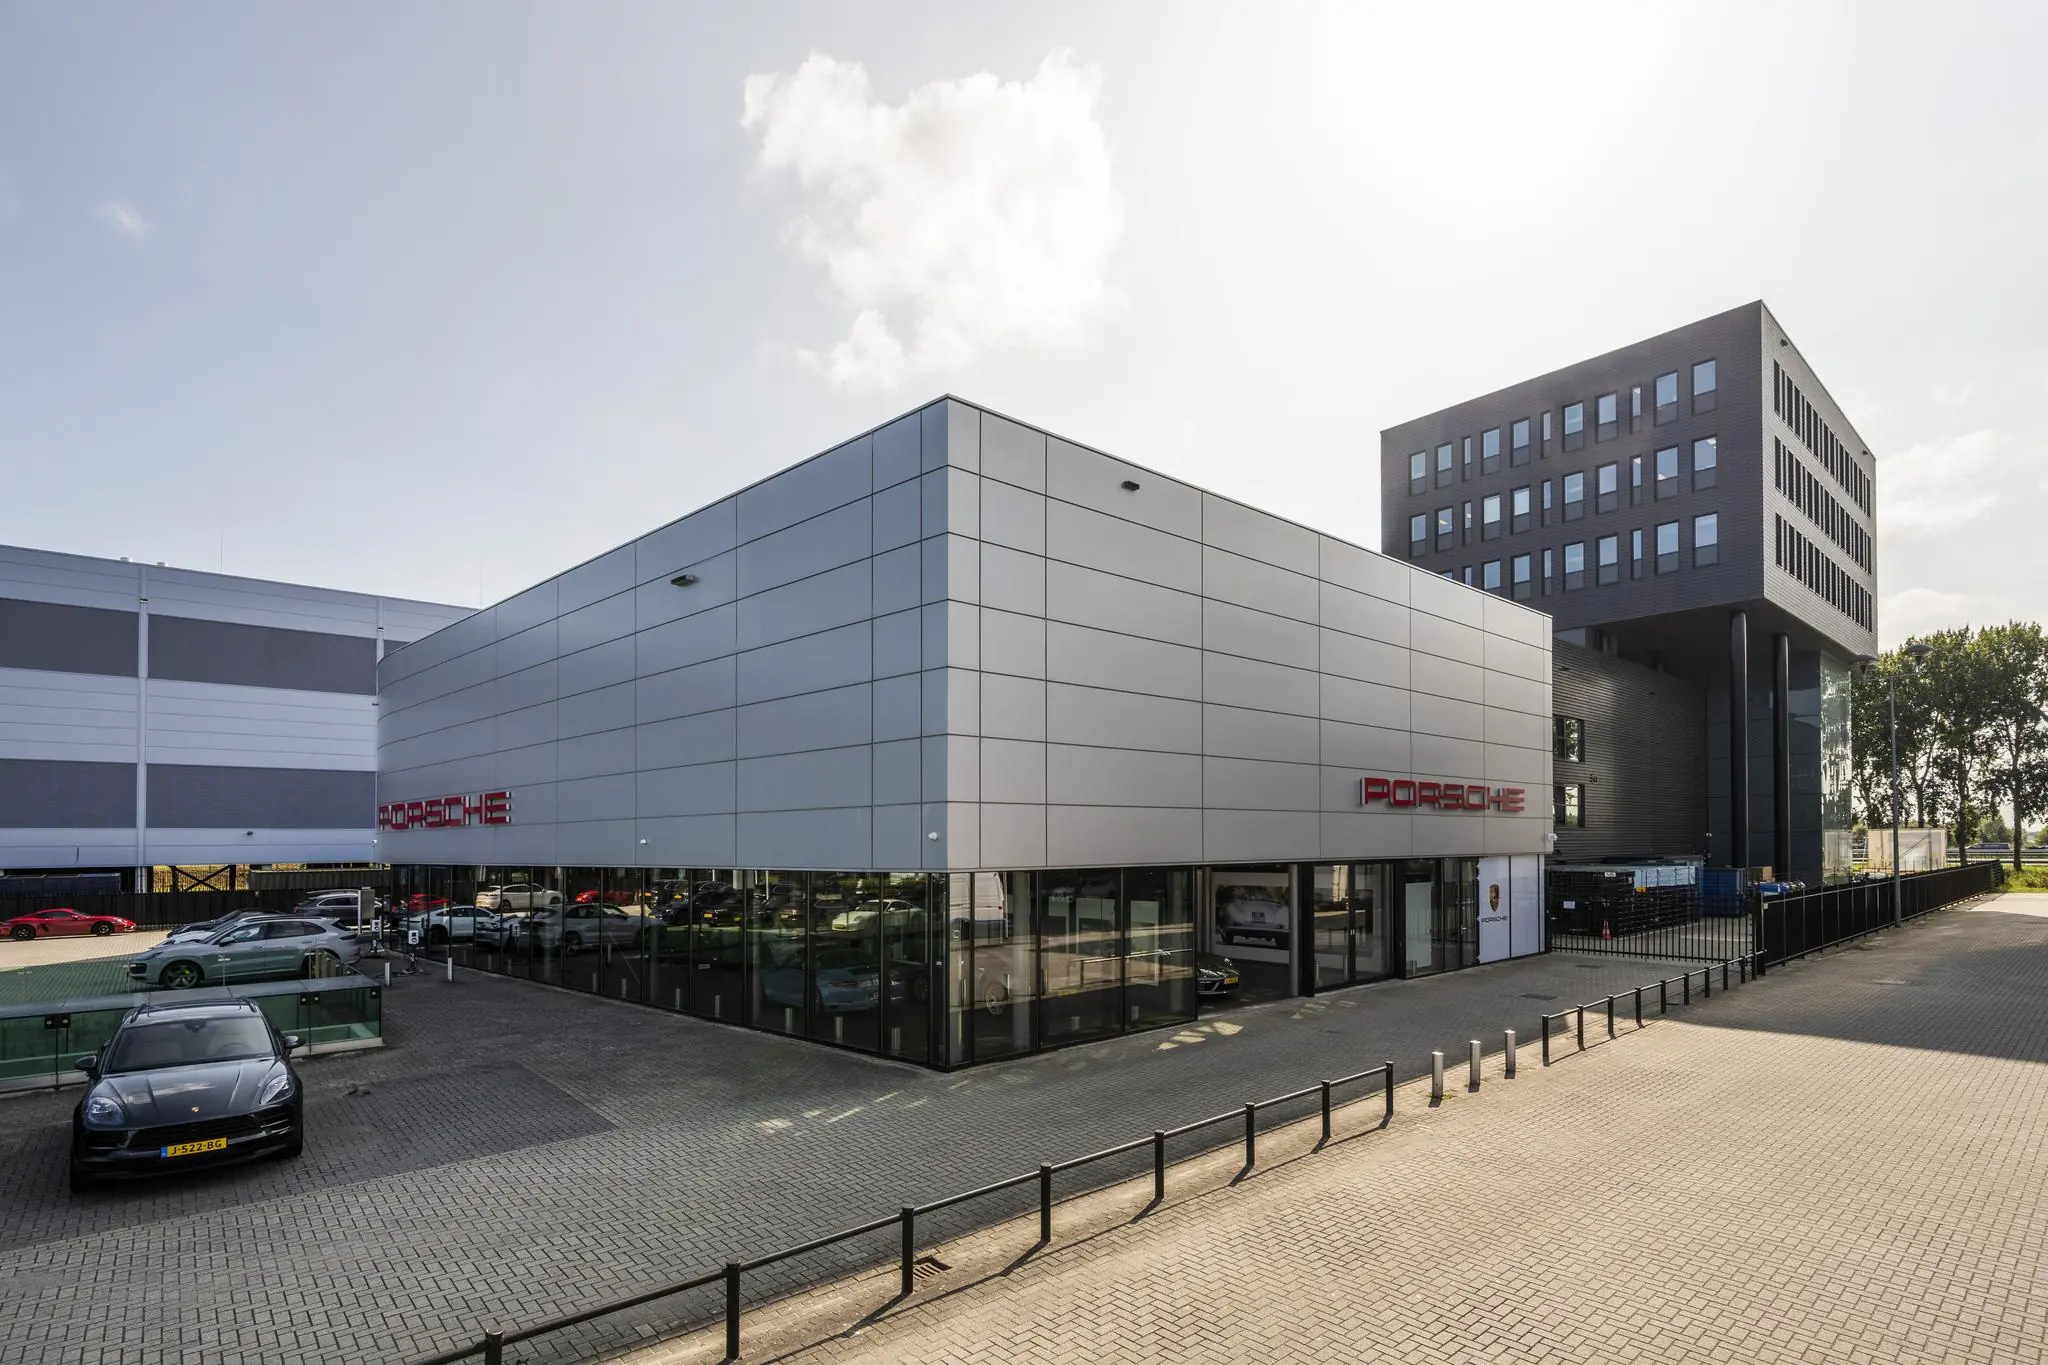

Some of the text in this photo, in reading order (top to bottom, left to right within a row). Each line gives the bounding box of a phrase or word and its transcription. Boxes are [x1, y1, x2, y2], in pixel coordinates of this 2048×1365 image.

[379, 791, 511, 829] PORSCHE
[1361, 777, 1525, 811] PORSCHE
[171, 1140, 222, 1154] J-522-BG
